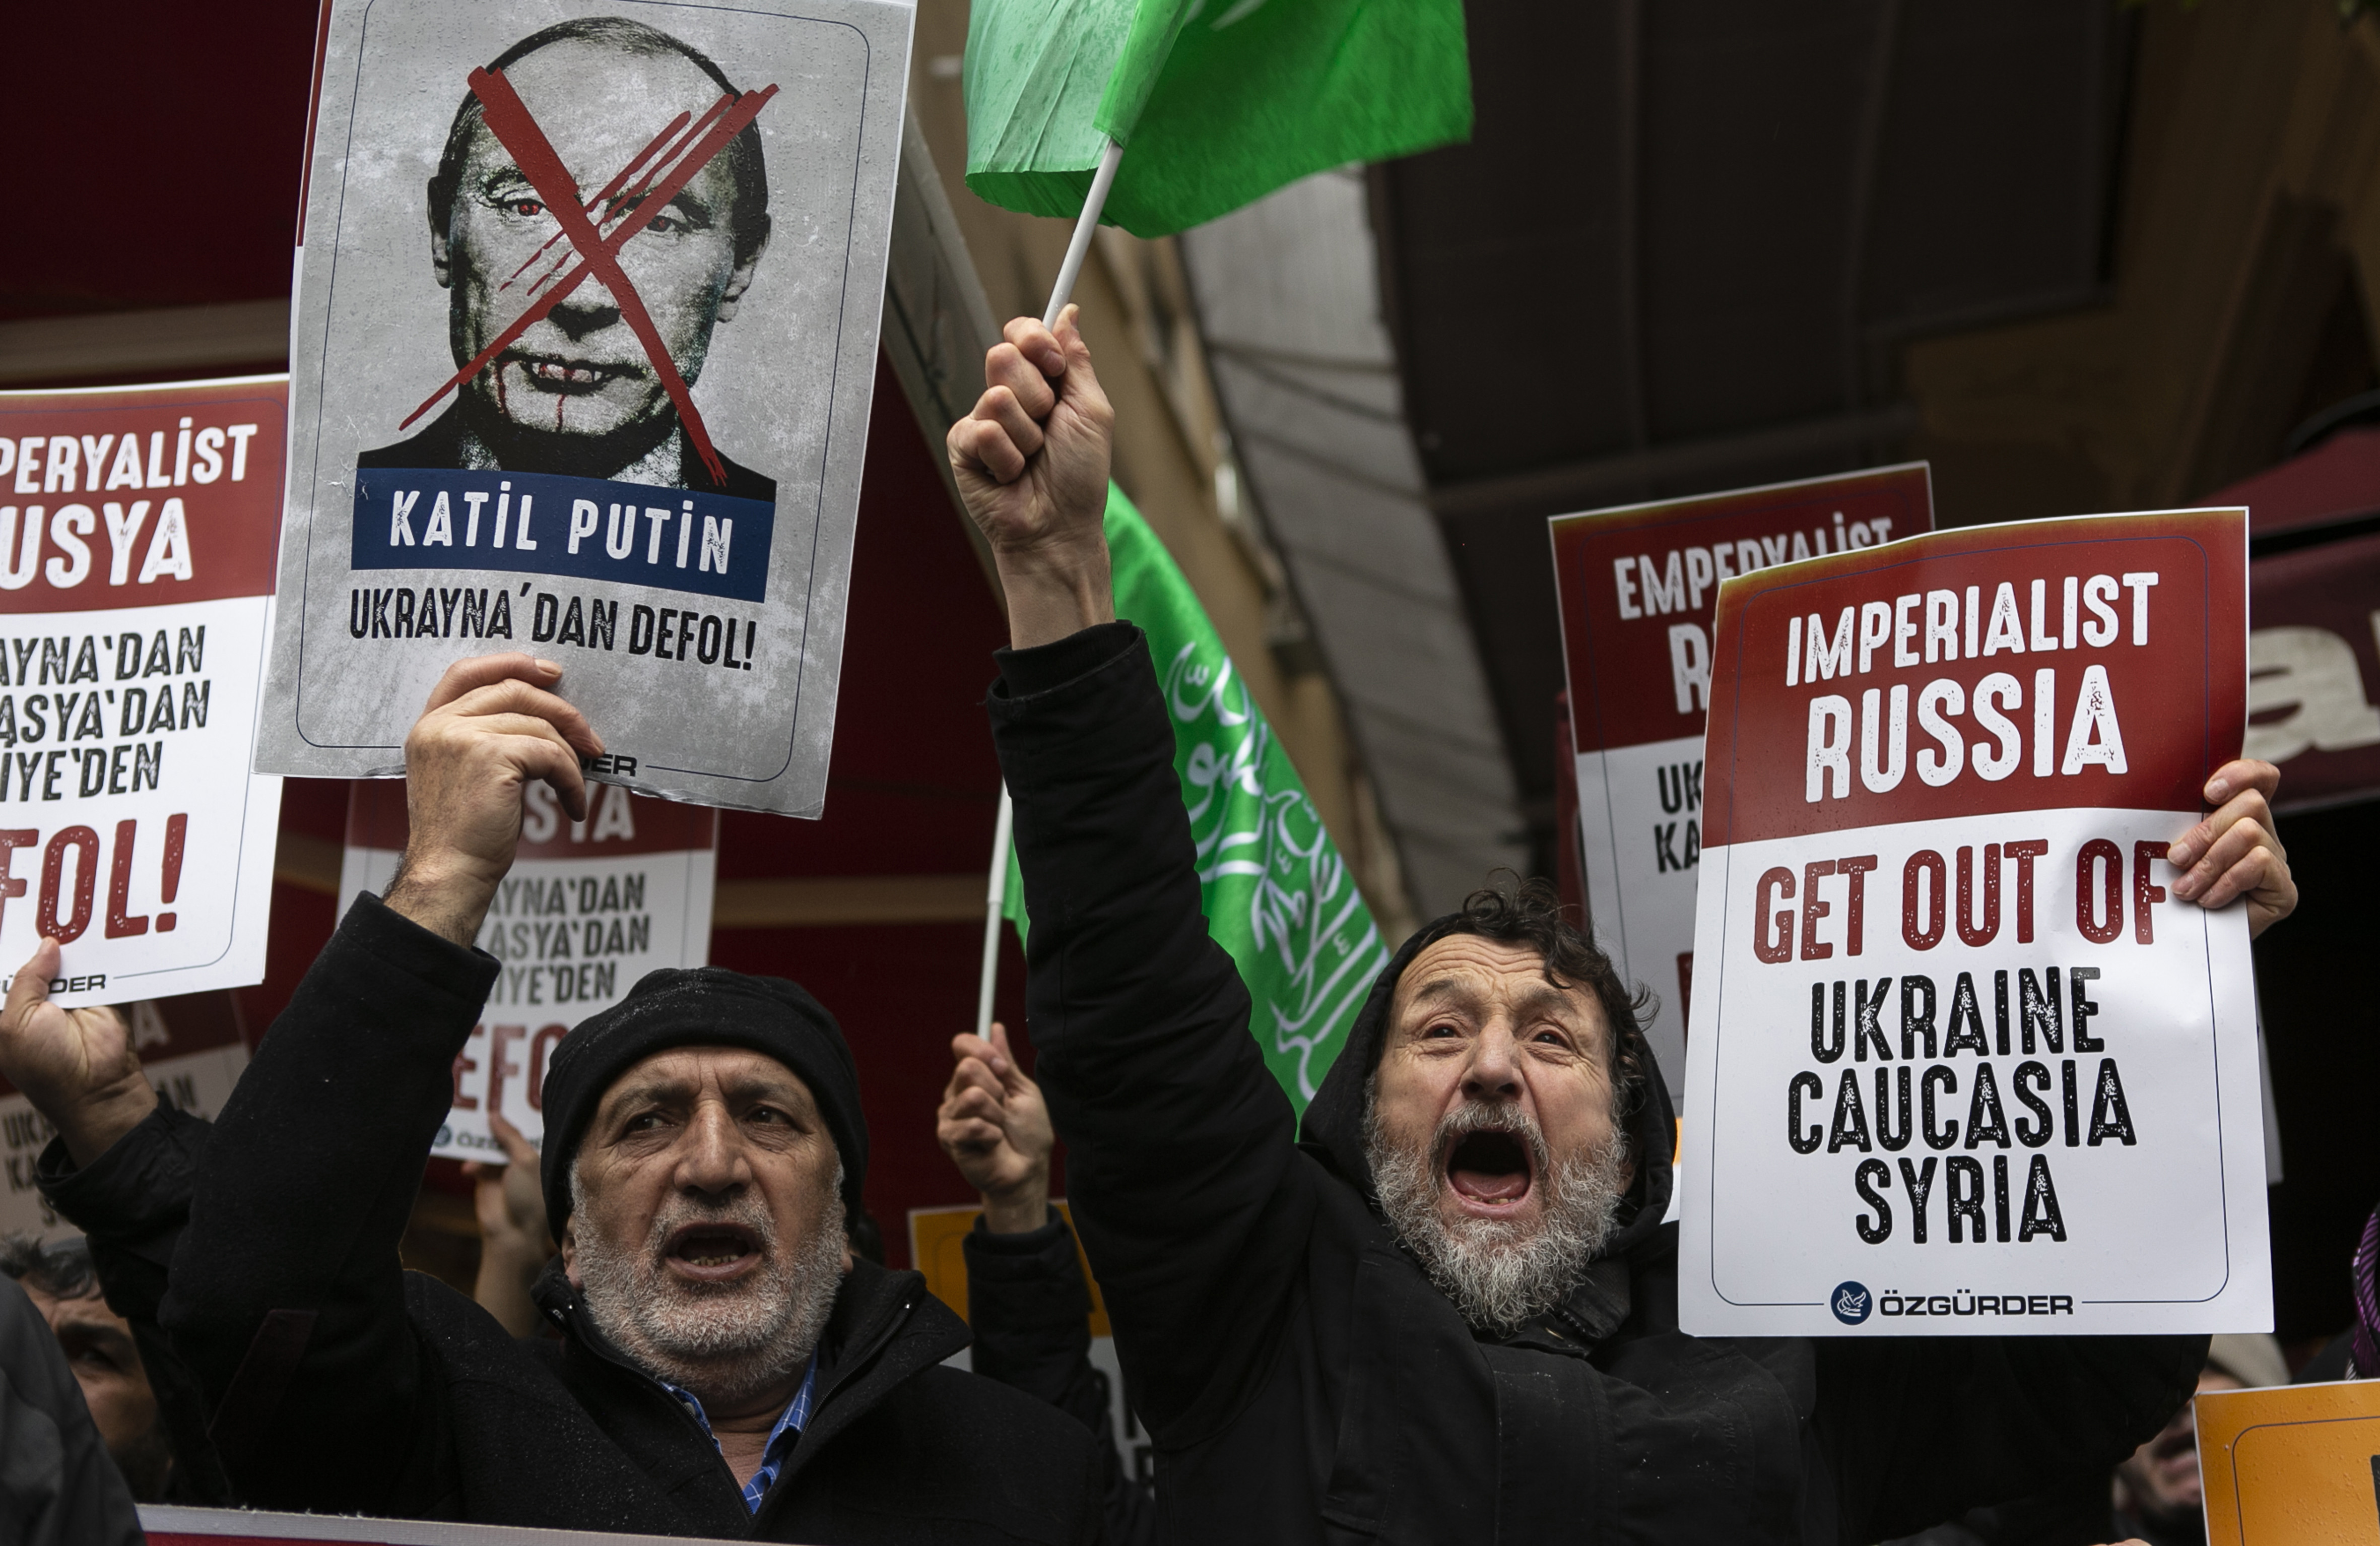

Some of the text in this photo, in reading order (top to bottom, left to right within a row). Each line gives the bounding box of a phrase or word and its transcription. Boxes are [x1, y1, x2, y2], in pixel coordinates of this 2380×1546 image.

[389, 481, 732, 574] KATİL PUTİN
[628, 604, 757, 671] DEFOL!
[1787, 572, 2158, 687] IMPERIALIST
[1806, 664, 2128, 803] RUSSIA
[1754, 838, 2170, 964] GET OUT OF
[1811, 966, 2104, 1064] UKRAINE
[1788, 1058, 2137, 1155] CAUCASIA
[1855, 1154, 2067, 1245] SYRIA
[1880, 1289, 2074, 1316] ÖZGÜRDER
